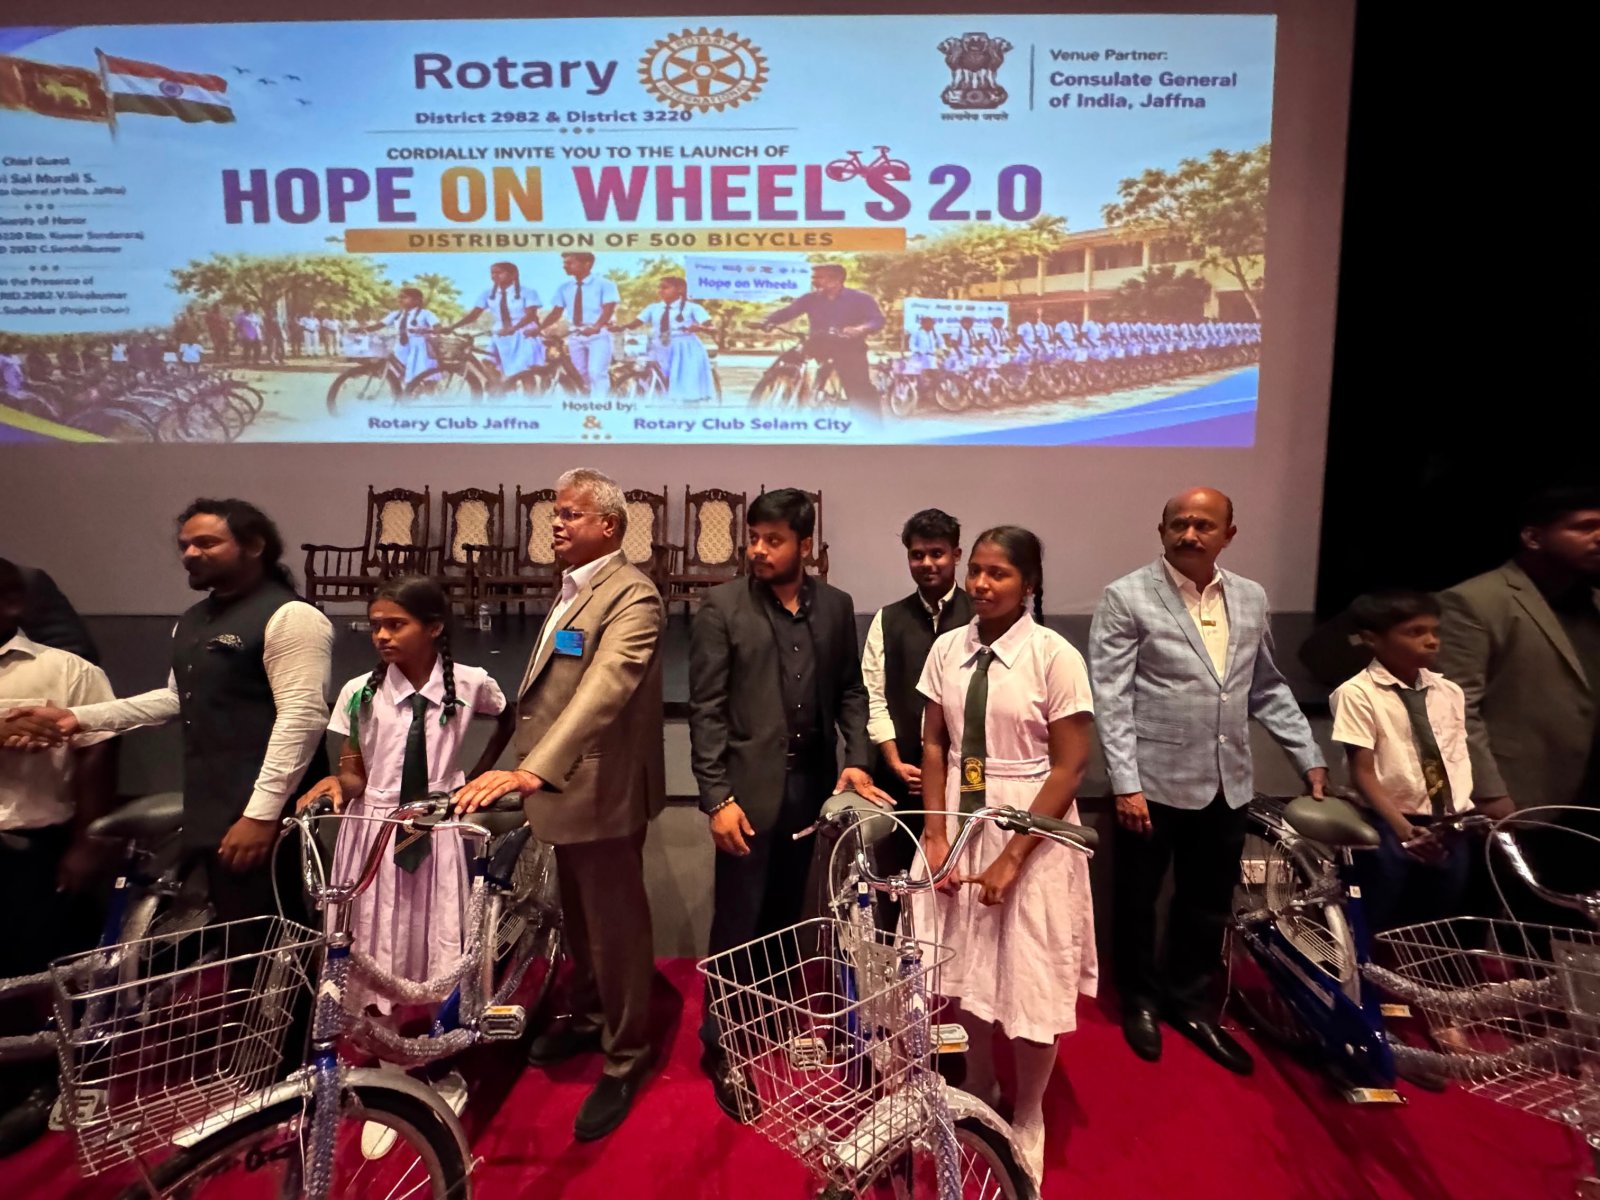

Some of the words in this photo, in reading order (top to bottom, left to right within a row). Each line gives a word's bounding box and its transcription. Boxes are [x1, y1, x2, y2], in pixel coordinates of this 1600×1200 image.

[1050, 49, 1099, 61] Venue
[1105, 49, 1168, 61] Partner:
[414, 53, 618, 95] Rotary
[1050, 71, 1152, 87] Consulate
[1159, 72, 1237, 87] General
[1050, 93, 1071, 108] of
[1077, 93, 1133, 110] India,
[1140, 94, 1206, 109] Jaffna
[415, 111, 486, 124] District
[491, 111, 540, 124] 2982
[545, 111, 561, 123] &
[567, 110, 637, 123] District
[643, 110, 692, 122] 3220
[387, 148, 489, 160] CORDIALLY
[494, 147, 555, 159] INVITE
[562, 147, 600, 159] YOU
[606, 147, 631, 159] TO
[637, 146, 674, 158] THE
[680, 146, 764, 158] LAUNCH
[769, 145, 790, 158] OF
[222, 166, 417, 224] HOPE
[440, 165, 544, 223] ON
[572, 163, 912, 222] WHEELS
[928, 164, 1043, 222] 2.0
[409, 233, 595, 247] DISTRIBUTION
[605, 233, 637, 247] OF
[650, 233, 696, 246] 500
[707, 232, 834, 247] BICYCLES
[698, 278, 732, 291] Hope
[735, 280, 750, 289] on
[753, 279, 798, 290] Wheels
[562, 400, 612, 411] Hosted
[367, 417, 430, 432] Rotary
[435, 417, 478, 430] Club
[482, 416, 539, 430] Jaffna
[582, 416, 603, 430] &
[633, 417, 695, 433] Rotary
[702, 417, 745, 431] Club
[750, 417, 808, 431] Selam
[814, 417, 852, 433] City
